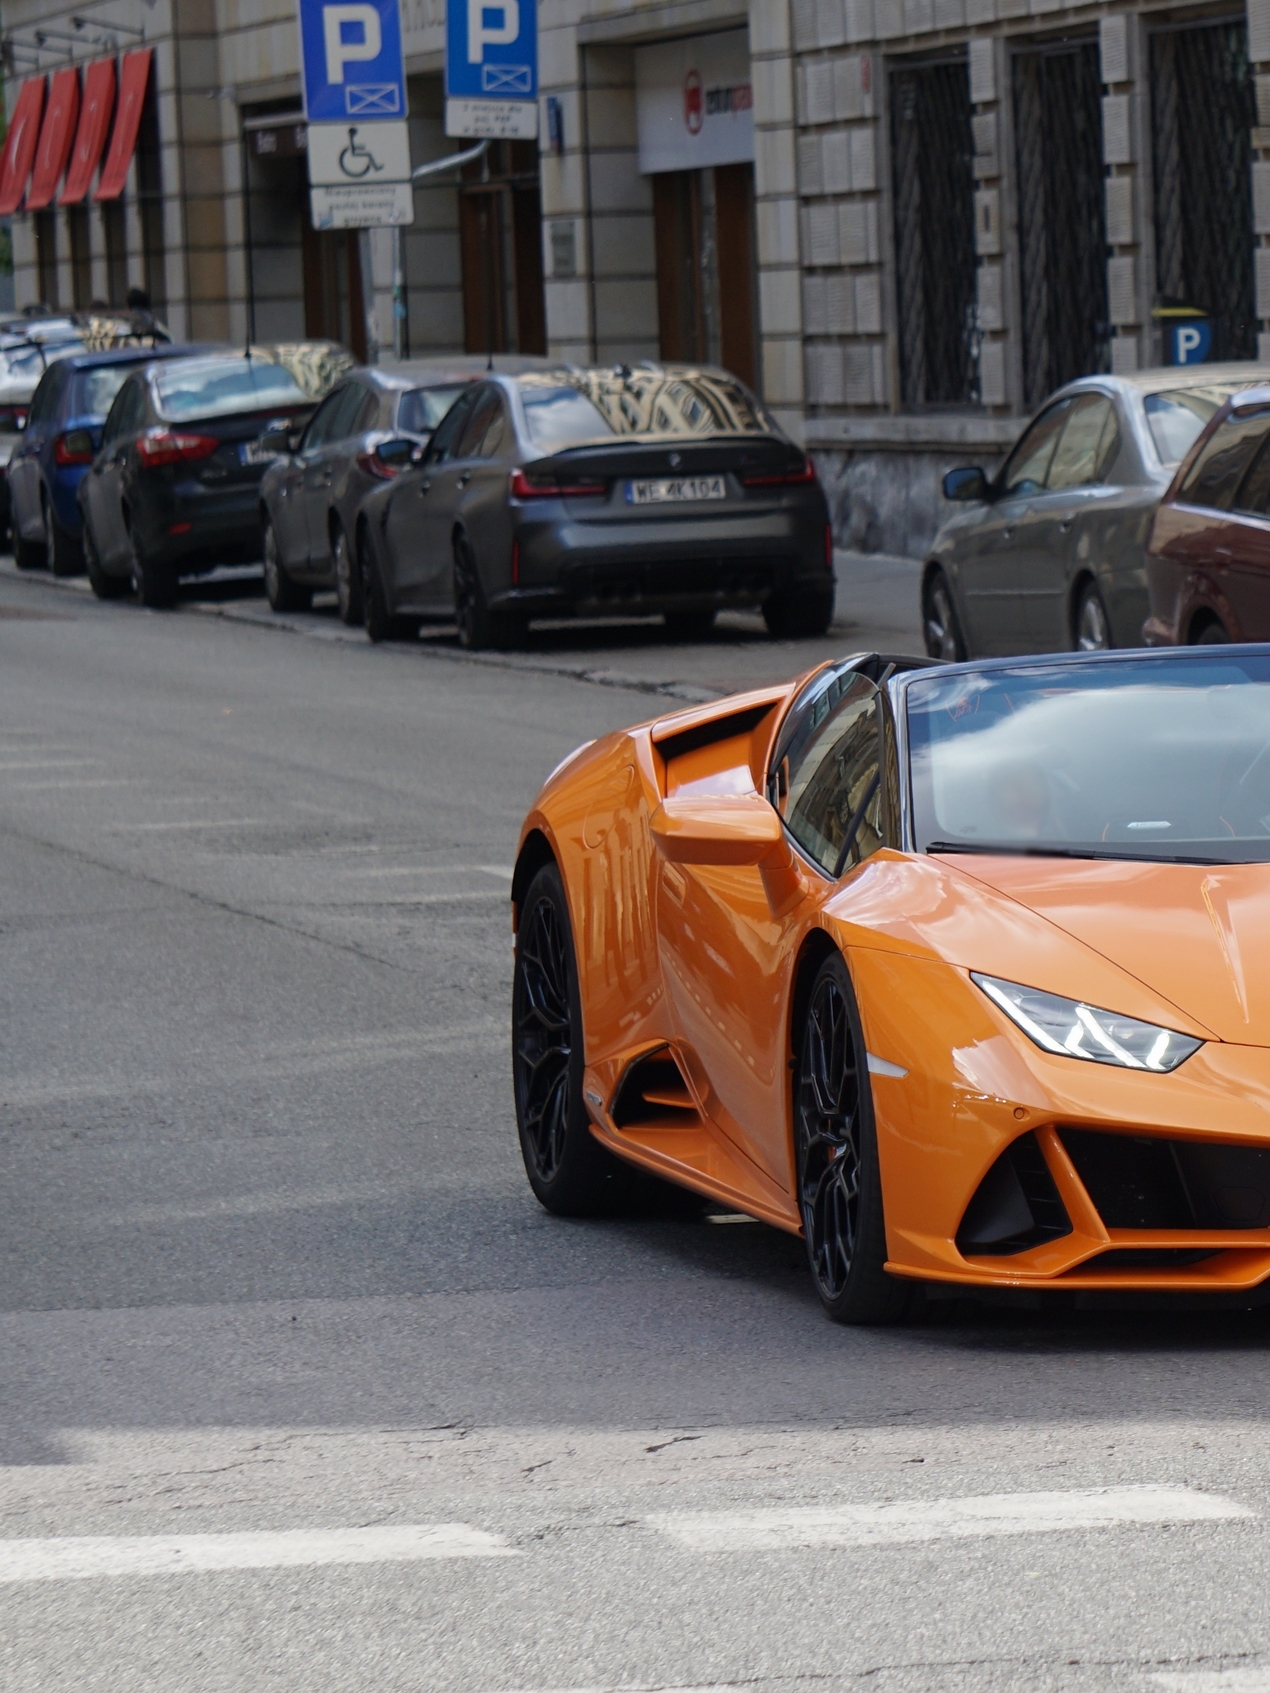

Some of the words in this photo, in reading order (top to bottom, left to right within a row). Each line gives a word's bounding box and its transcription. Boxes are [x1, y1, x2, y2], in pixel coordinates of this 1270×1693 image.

[323, 5, 382, 85] P
[467, 0, 520, 64] P
[1178, 326, 1201, 363] P
